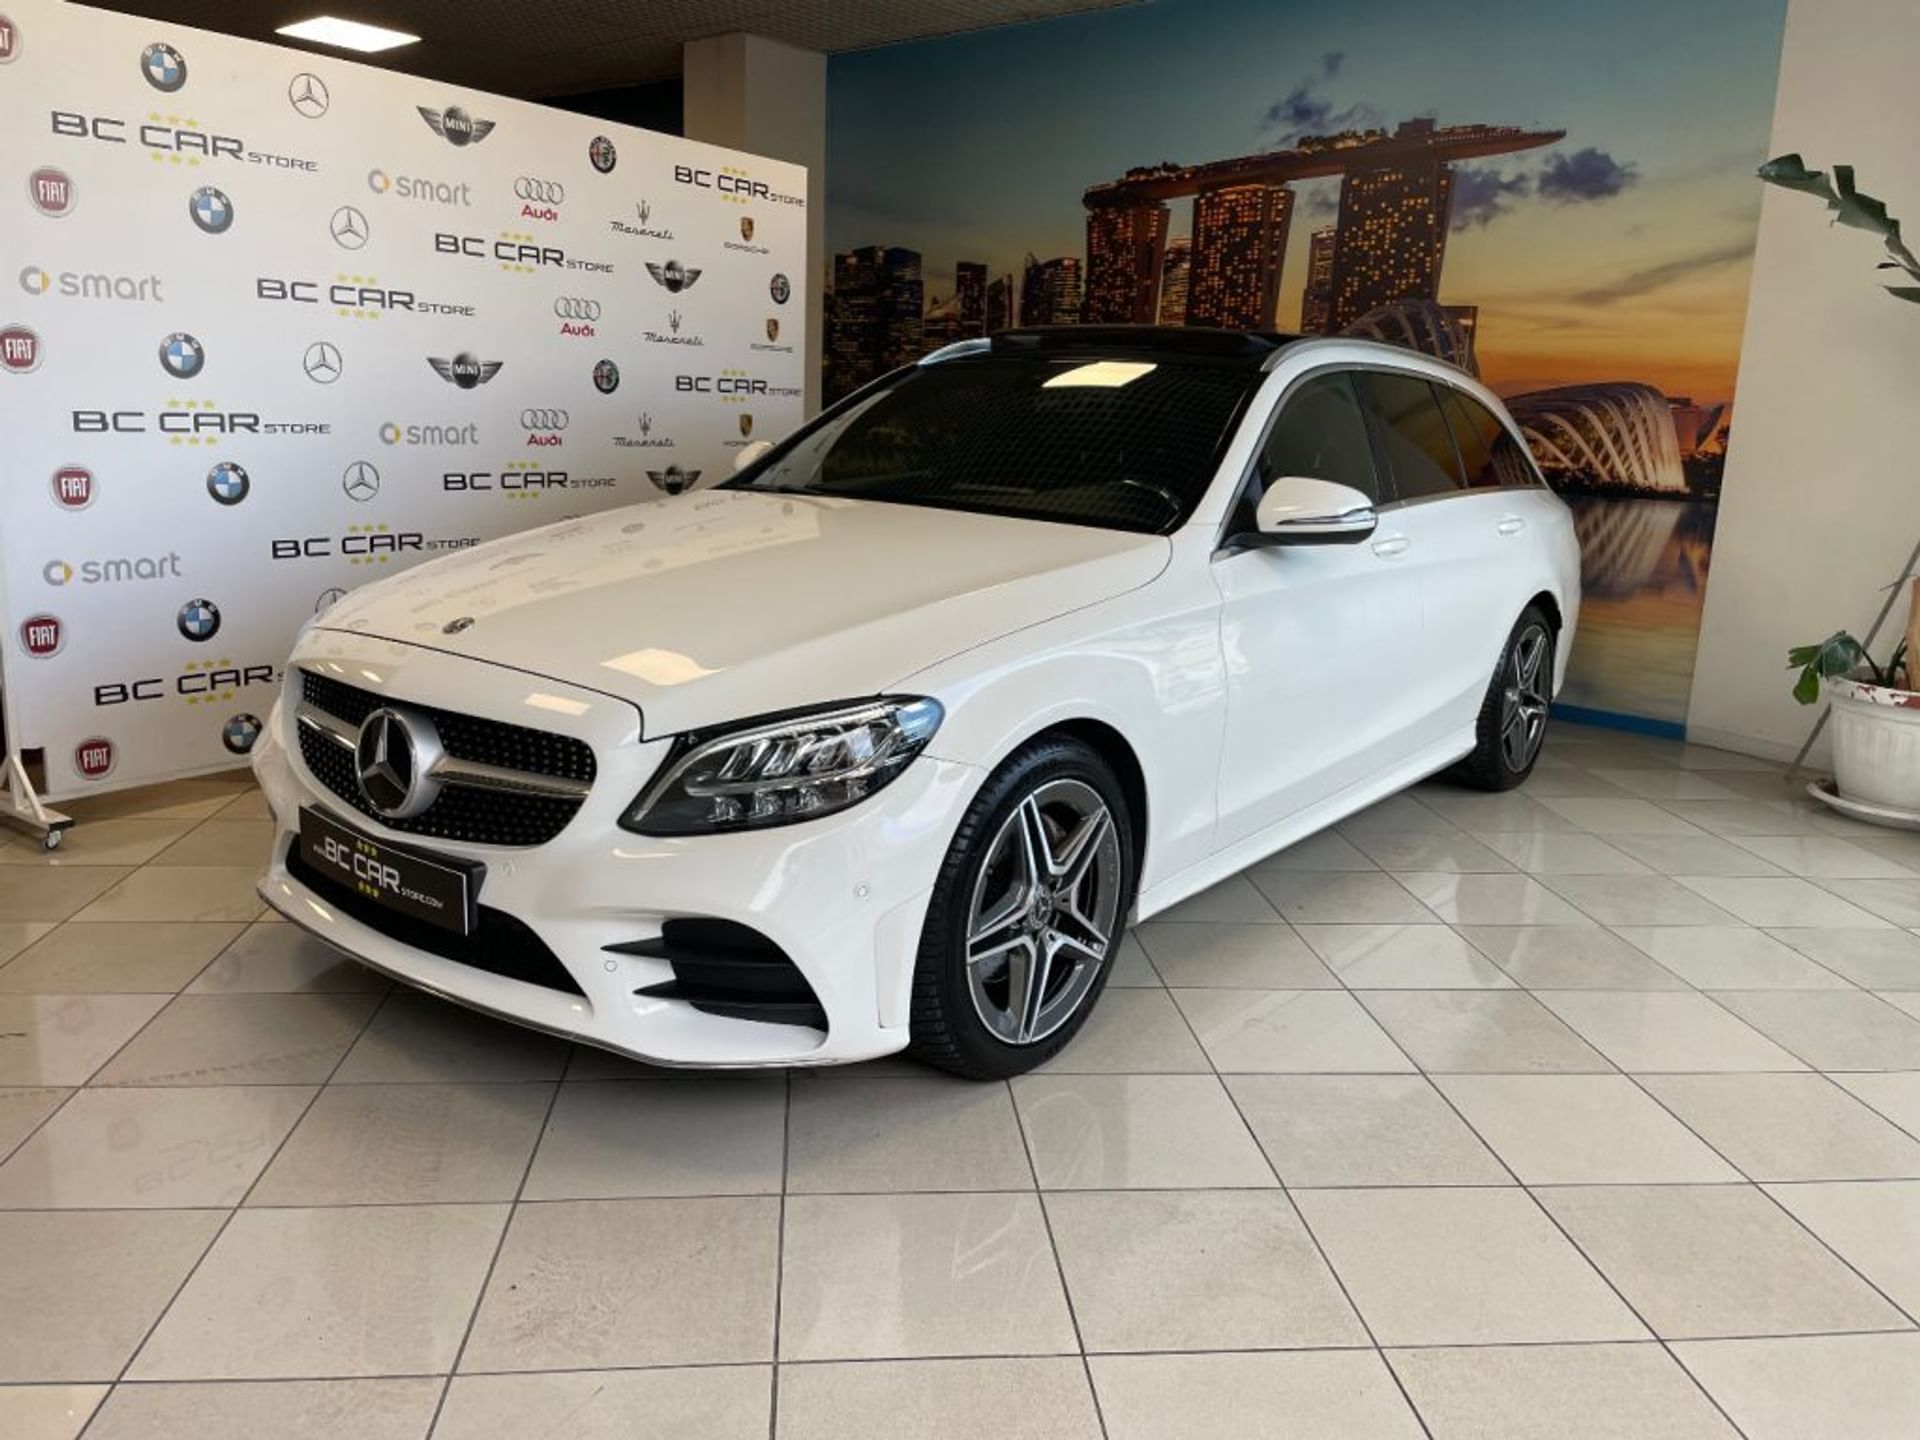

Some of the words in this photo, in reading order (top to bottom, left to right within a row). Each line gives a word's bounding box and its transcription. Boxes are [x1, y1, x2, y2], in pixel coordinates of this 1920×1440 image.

[446, 117, 472, 133] MINI
[51, 110, 126, 143] BC
[140, 125, 244, 160] CAR
[247, 151, 319, 172] STORE
[38, 180, 66, 203] FIAT
[395, 175, 471, 207] smart
[674, 165, 711, 188] BC
[717, 174, 769, 199] CAR
[769, 192, 805, 207] STORE
[521, 203, 558, 221] Audi
[435, 232, 486, 257] BC
[494, 241, 564, 267] CAR
[566, 259, 614, 273] STORE
[59, 271, 164, 303] smart
[257, 278, 318, 303] BC
[330, 285, 415, 311] CAR
[417, 302, 476, 317] STORE
[560, 322, 596, 337] Audi
[5, 338, 34, 361] FIAT
[454, 364, 478, 375] MINI
[675, 375, 712, 392] BC
[717, 378, 767, 395] CAR
[72, 410, 146, 433] BC
[159, 412, 260, 434] CAR
[263, 423, 331, 434] STORE
[406, 422, 479, 445] smart
[527, 433, 562, 446] Audi
[60, 477, 88, 498] FIAT
[444, 473, 492, 490] BC
[500, 472, 568, 490] CAR
[570, 478, 616, 489] STORE
[272, 537, 331, 559] BC
[341, 533, 423, 555] CAR
[81, 552, 181, 584] smart
[29, 625, 55, 647] FIAT
[94, 678, 164, 706] BC
[177, 665, 273, 694] CAR
[83, 748, 108, 769] FIAT
[323, 836, 350, 872] BC
[353, 852, 400, 894] CAR
